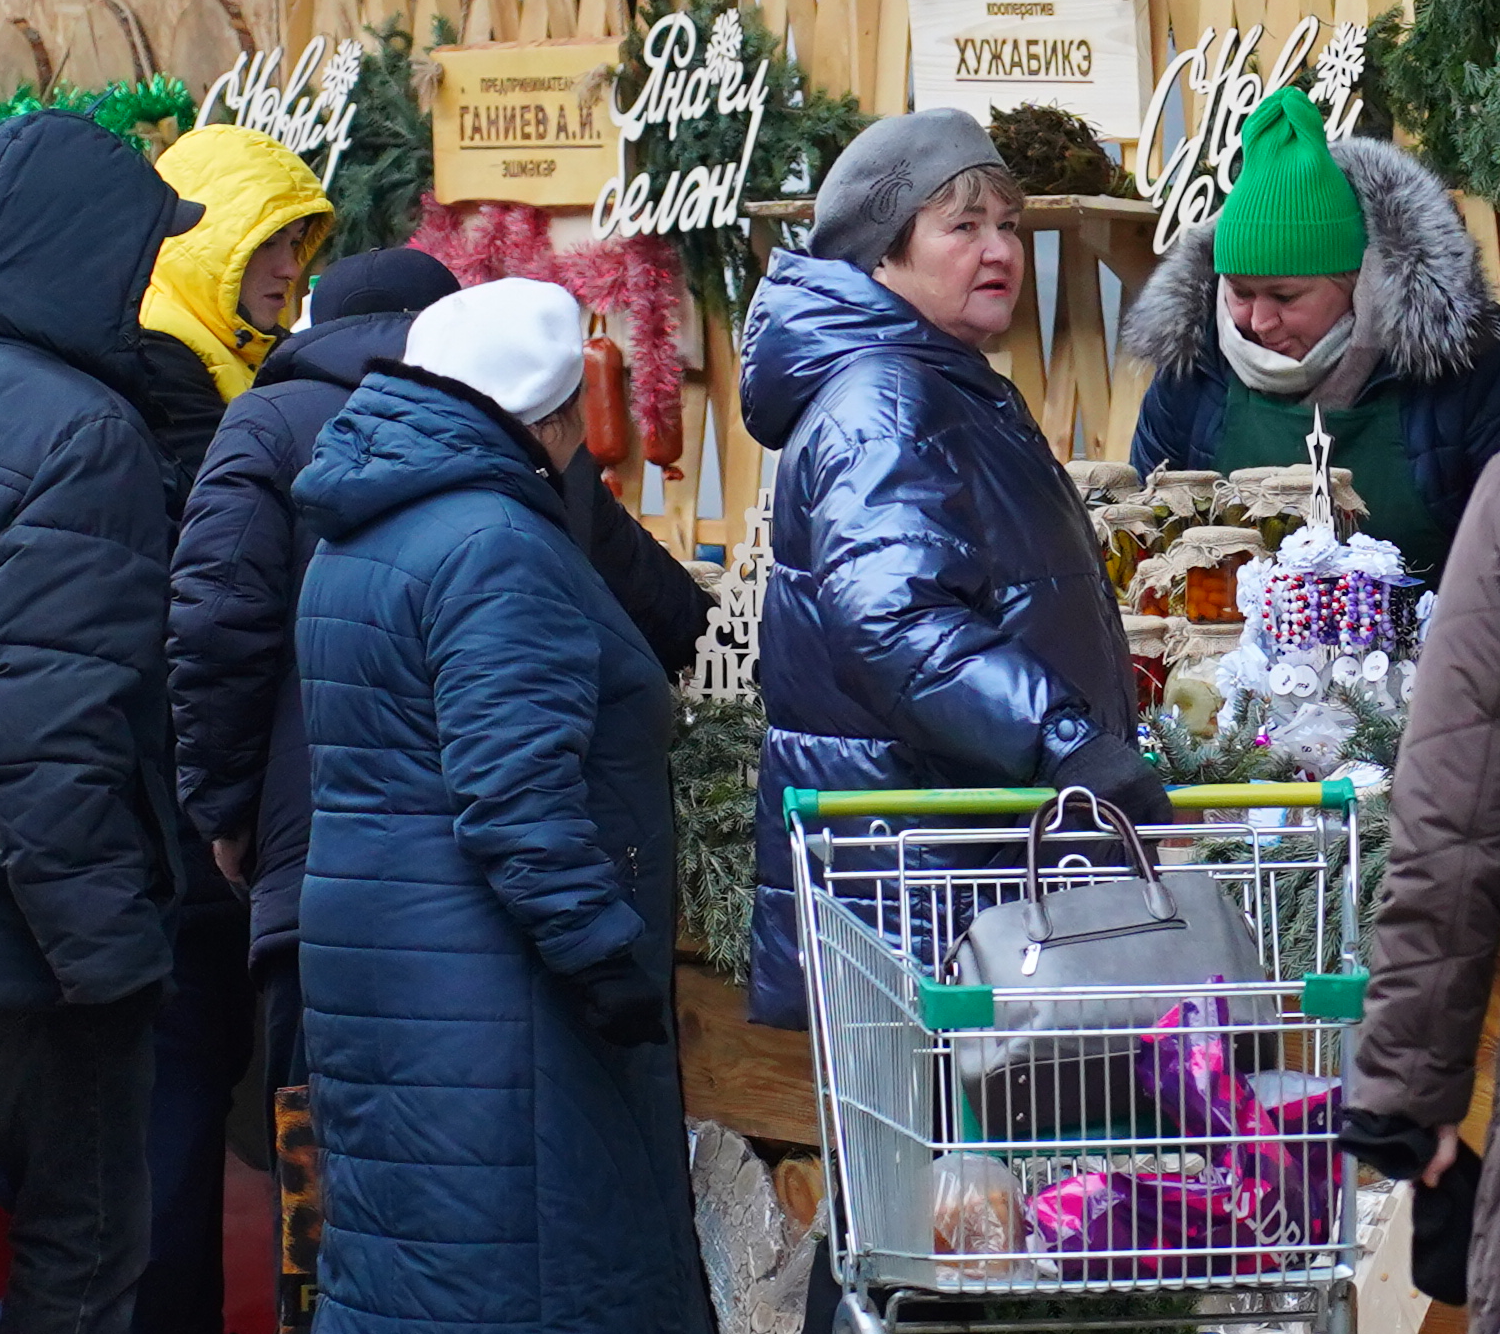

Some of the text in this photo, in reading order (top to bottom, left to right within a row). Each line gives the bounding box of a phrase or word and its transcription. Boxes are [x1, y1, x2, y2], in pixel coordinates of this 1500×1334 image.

[986, 2, 1055, 20] кооператив
[955, 38, 1092, 77] ХУЖАБИКЭ
[459, 105, 548, 141] ГАНИЕВ
